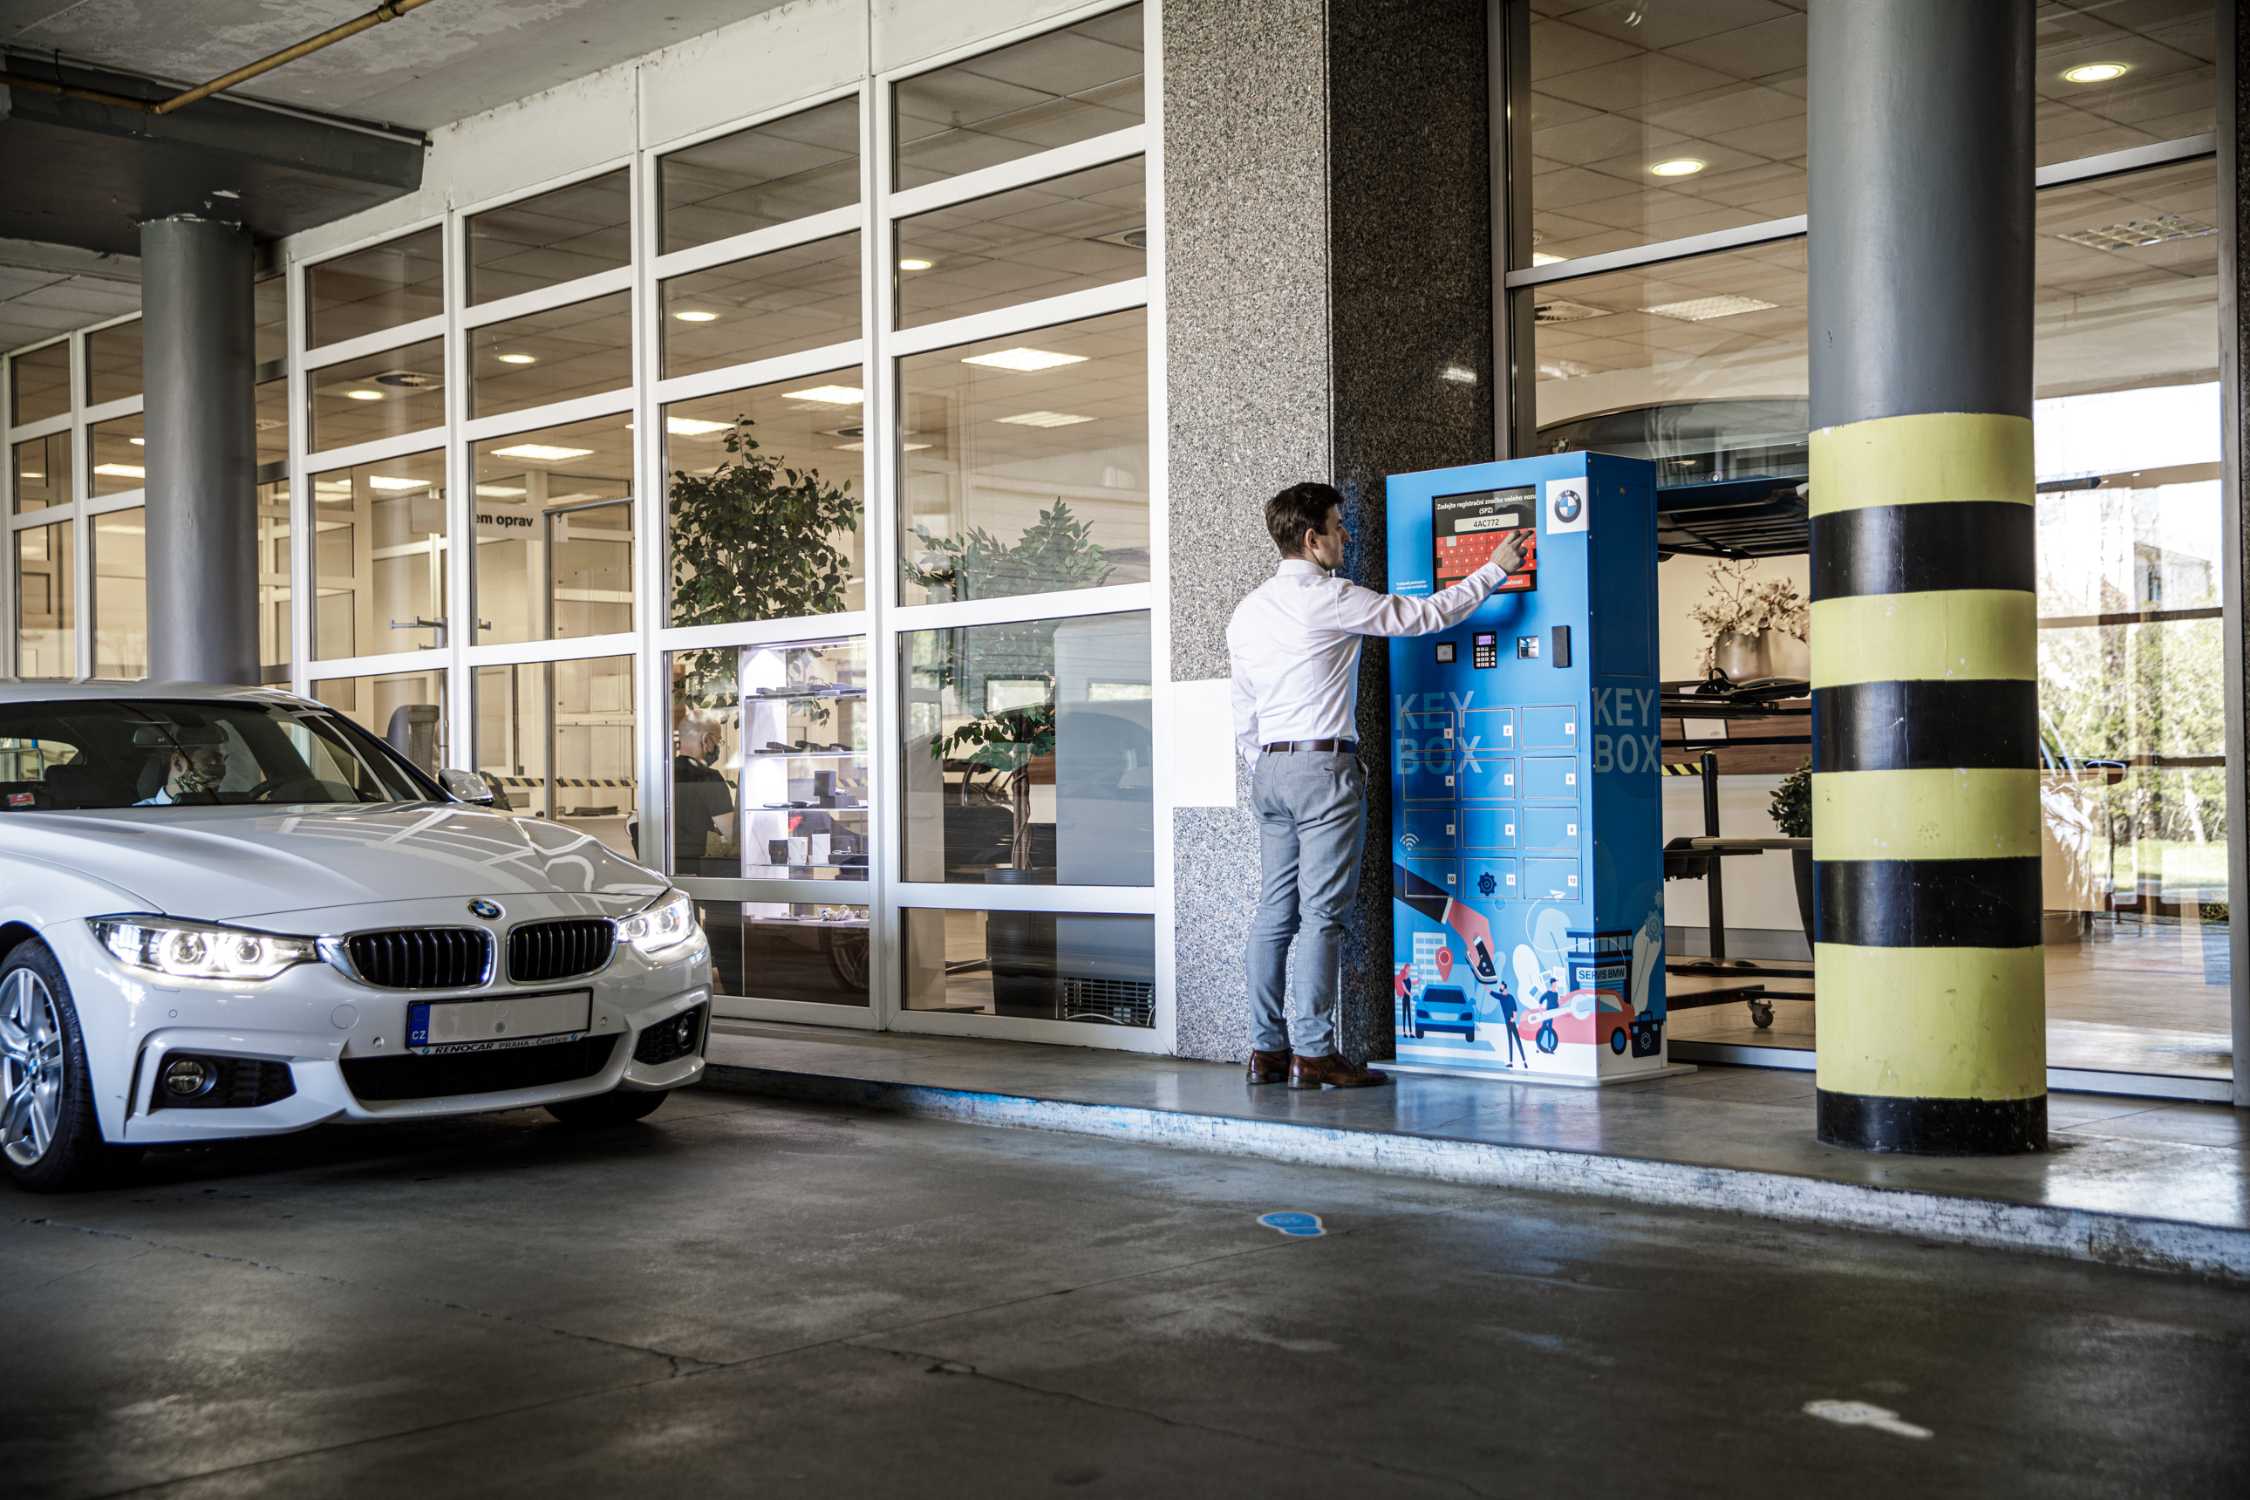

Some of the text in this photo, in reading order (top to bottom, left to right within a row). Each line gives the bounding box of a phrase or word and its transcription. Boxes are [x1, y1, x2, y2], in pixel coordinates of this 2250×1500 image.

[496, 515, 533, 528] oprav
[1395, 690, 1474, 730] KEY
[1592, 687, 1655, 727] KEY
[1395, 736, 1482, 774] BOX
[1594, 733, 1660, 774] BOX
[1578, 967, 1625, 980] SERVIS BMW
[412, 1030, 426, 1040] CZ
[435, 1042, 494, 1054] RENOCAR
